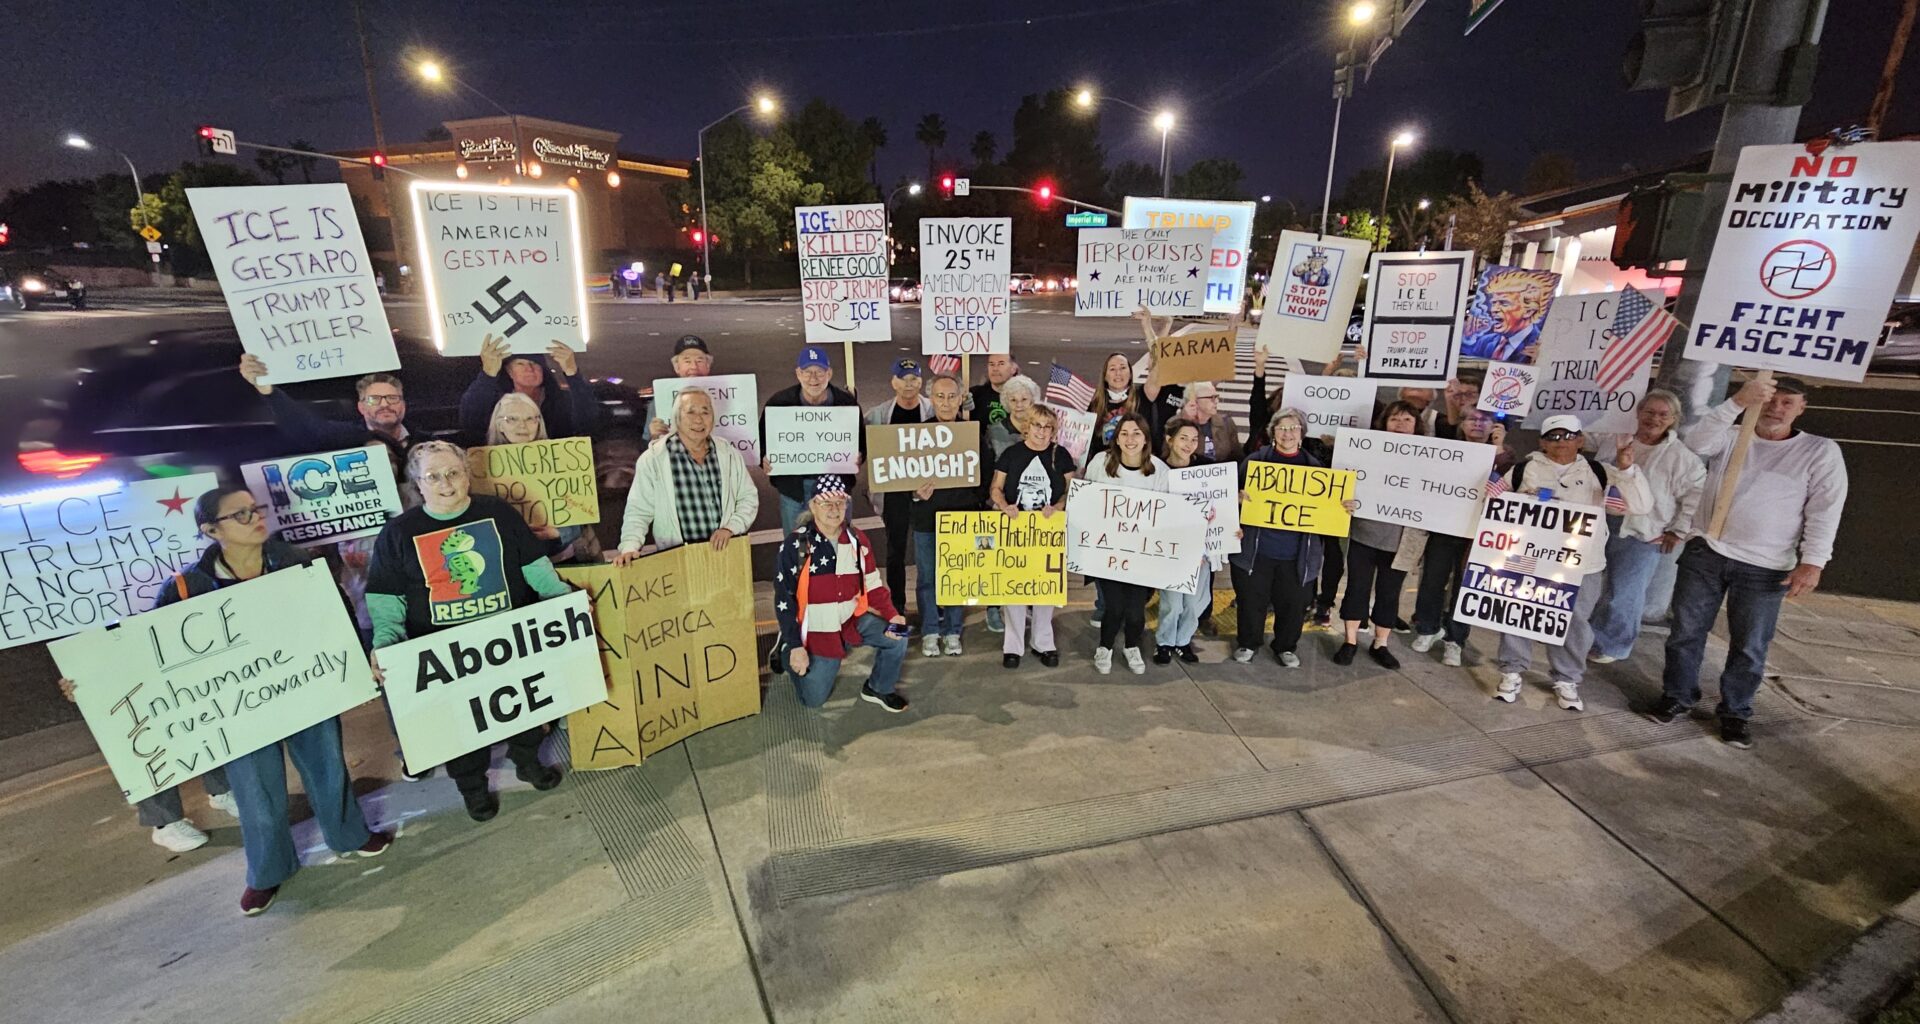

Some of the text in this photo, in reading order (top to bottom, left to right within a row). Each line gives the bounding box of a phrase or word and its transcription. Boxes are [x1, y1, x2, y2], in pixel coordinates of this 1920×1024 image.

[1790, 156, 1857, 178] NO
[425, 191, 560, 213] ICE IS THE
[1734, 180, 1908, 209] Military
[213, 206, 344, 249] ICE IS
[799, 211, 830, 232] ICE
[1146, 211, 1232, 233] TRUMP
[1728, 209, 1893, 230] OCCUPATION
[441, 224, 548, 241] AMERICAN
[925, 223, 1005, 245] INVOKE
[1120, 228, 1171, 240] THE ONLY
[806, 233, 877, 255] KILLED
[1080, 242, 1204, 264] TERRORISTS
[231, 249, 357, 282] GESTAPO
[801, 256, 887, 278] RENEE GOOD
[1138, 263, 1169, 274] KNOW
[803, 279, 888, 300] STOP TRUMP
[923, 273, 1010, 293] AMENDMENT
[1114, 274, 1179, 285] ARE IN THE
[1290, 284, 1327, 297] STOP
[1397, 272, 1437, 287] STOP
[243, 283, 366, 320] TRUMP IS
[1076, 288, 1197, 310] WHITE HOUSE
[1285, 294, 1328, 307] TRUMP
[1399, 288, 1427, 300] ICE
[805, 301, 880, 322] STOP ICE
[934, 296, 1007, 316] REMOVE!
[1287, 305, 1319, 317] NOW
[1392, 301, 1414, 311] THEY
[1730, 301, 1845, 331] FIGHT
[443, 311, 474, 328] 1933
[544, 315, 579, 328] 2025
[935, 315, 998, 331] SLEEPY
[260, 315, 372, 351] HITLER
[944, 331, 990, 353] DON
[1390, 331, 1426, 344] STOP
[1160, 337, 1230, 358] KARMA
[1694, 323, 1869, 366] FASCISM
[296, 347, 344, 371] 8647
[1382, 358, 1427, 369] PIRATES
[1491, 366, 1535, 386] NO HUMAN
[1304, 386, 1351, 401] GOOD
[1491, 398, 1524, 410] ILLEGAL
[1536, 390, 1636, 413] GESTAPO
[795, 411, 832, 422] HONK
[1307, 412, 1359, 427] OUBLE
[778, 431, 852, 443] FOR YOUR
[897, 425, 953, 452] HAD
[470, 441, 591, 479] CONGRESS
[769, 451, 851, 464] DEMOCRACY
[1349, 437, 1464, 462] NO DICTATOR
[262, 450, 377, 506] ICE
[872, 450, 980, 485] ENOUGH?
[1181, 466, 1228, 480] ENOUGH
[538, 474, 594, 499] YOUR
[1248, 465, 1347, 501] ABOLISH
[1384, 474, 1410, 488] ICE
[1421, 479, 1479, 500] THUGS
[2, 491, 132, 545] ICE
[278, 498, 382, 526] MELTS UNDER
[1100, 488, 1166, 527] TRUMP
[1264, 500, 1317, 527] ICE
[1376, 503, 1423, 522] WARS
[1484, 497, 1597, 537] REMOVE
[281, 512, 387, 543] RESISTANCE
[938, 514, 967, 534] End
[972, 512, 997, 534] this
[1118, 521, 1128, 533] IS
[938, 542, 985, 573] Regime
[940, 574, 989, 597] Article
[1467, 564, 1575, 610] TAKE BACK
[435, 590, 508, 622] RESIST
[1460, 592, 1568, 638] CONGRESS
[149, 598, 242, 668] ICE
[416, 607, 594, 693] Abolish
[110, 649, 294, 739] Inhumane
[468, 671, 554, 734] ICE
[591, 701, 699, 762] AGAIN
[145, 727, 231, 791] Evil
